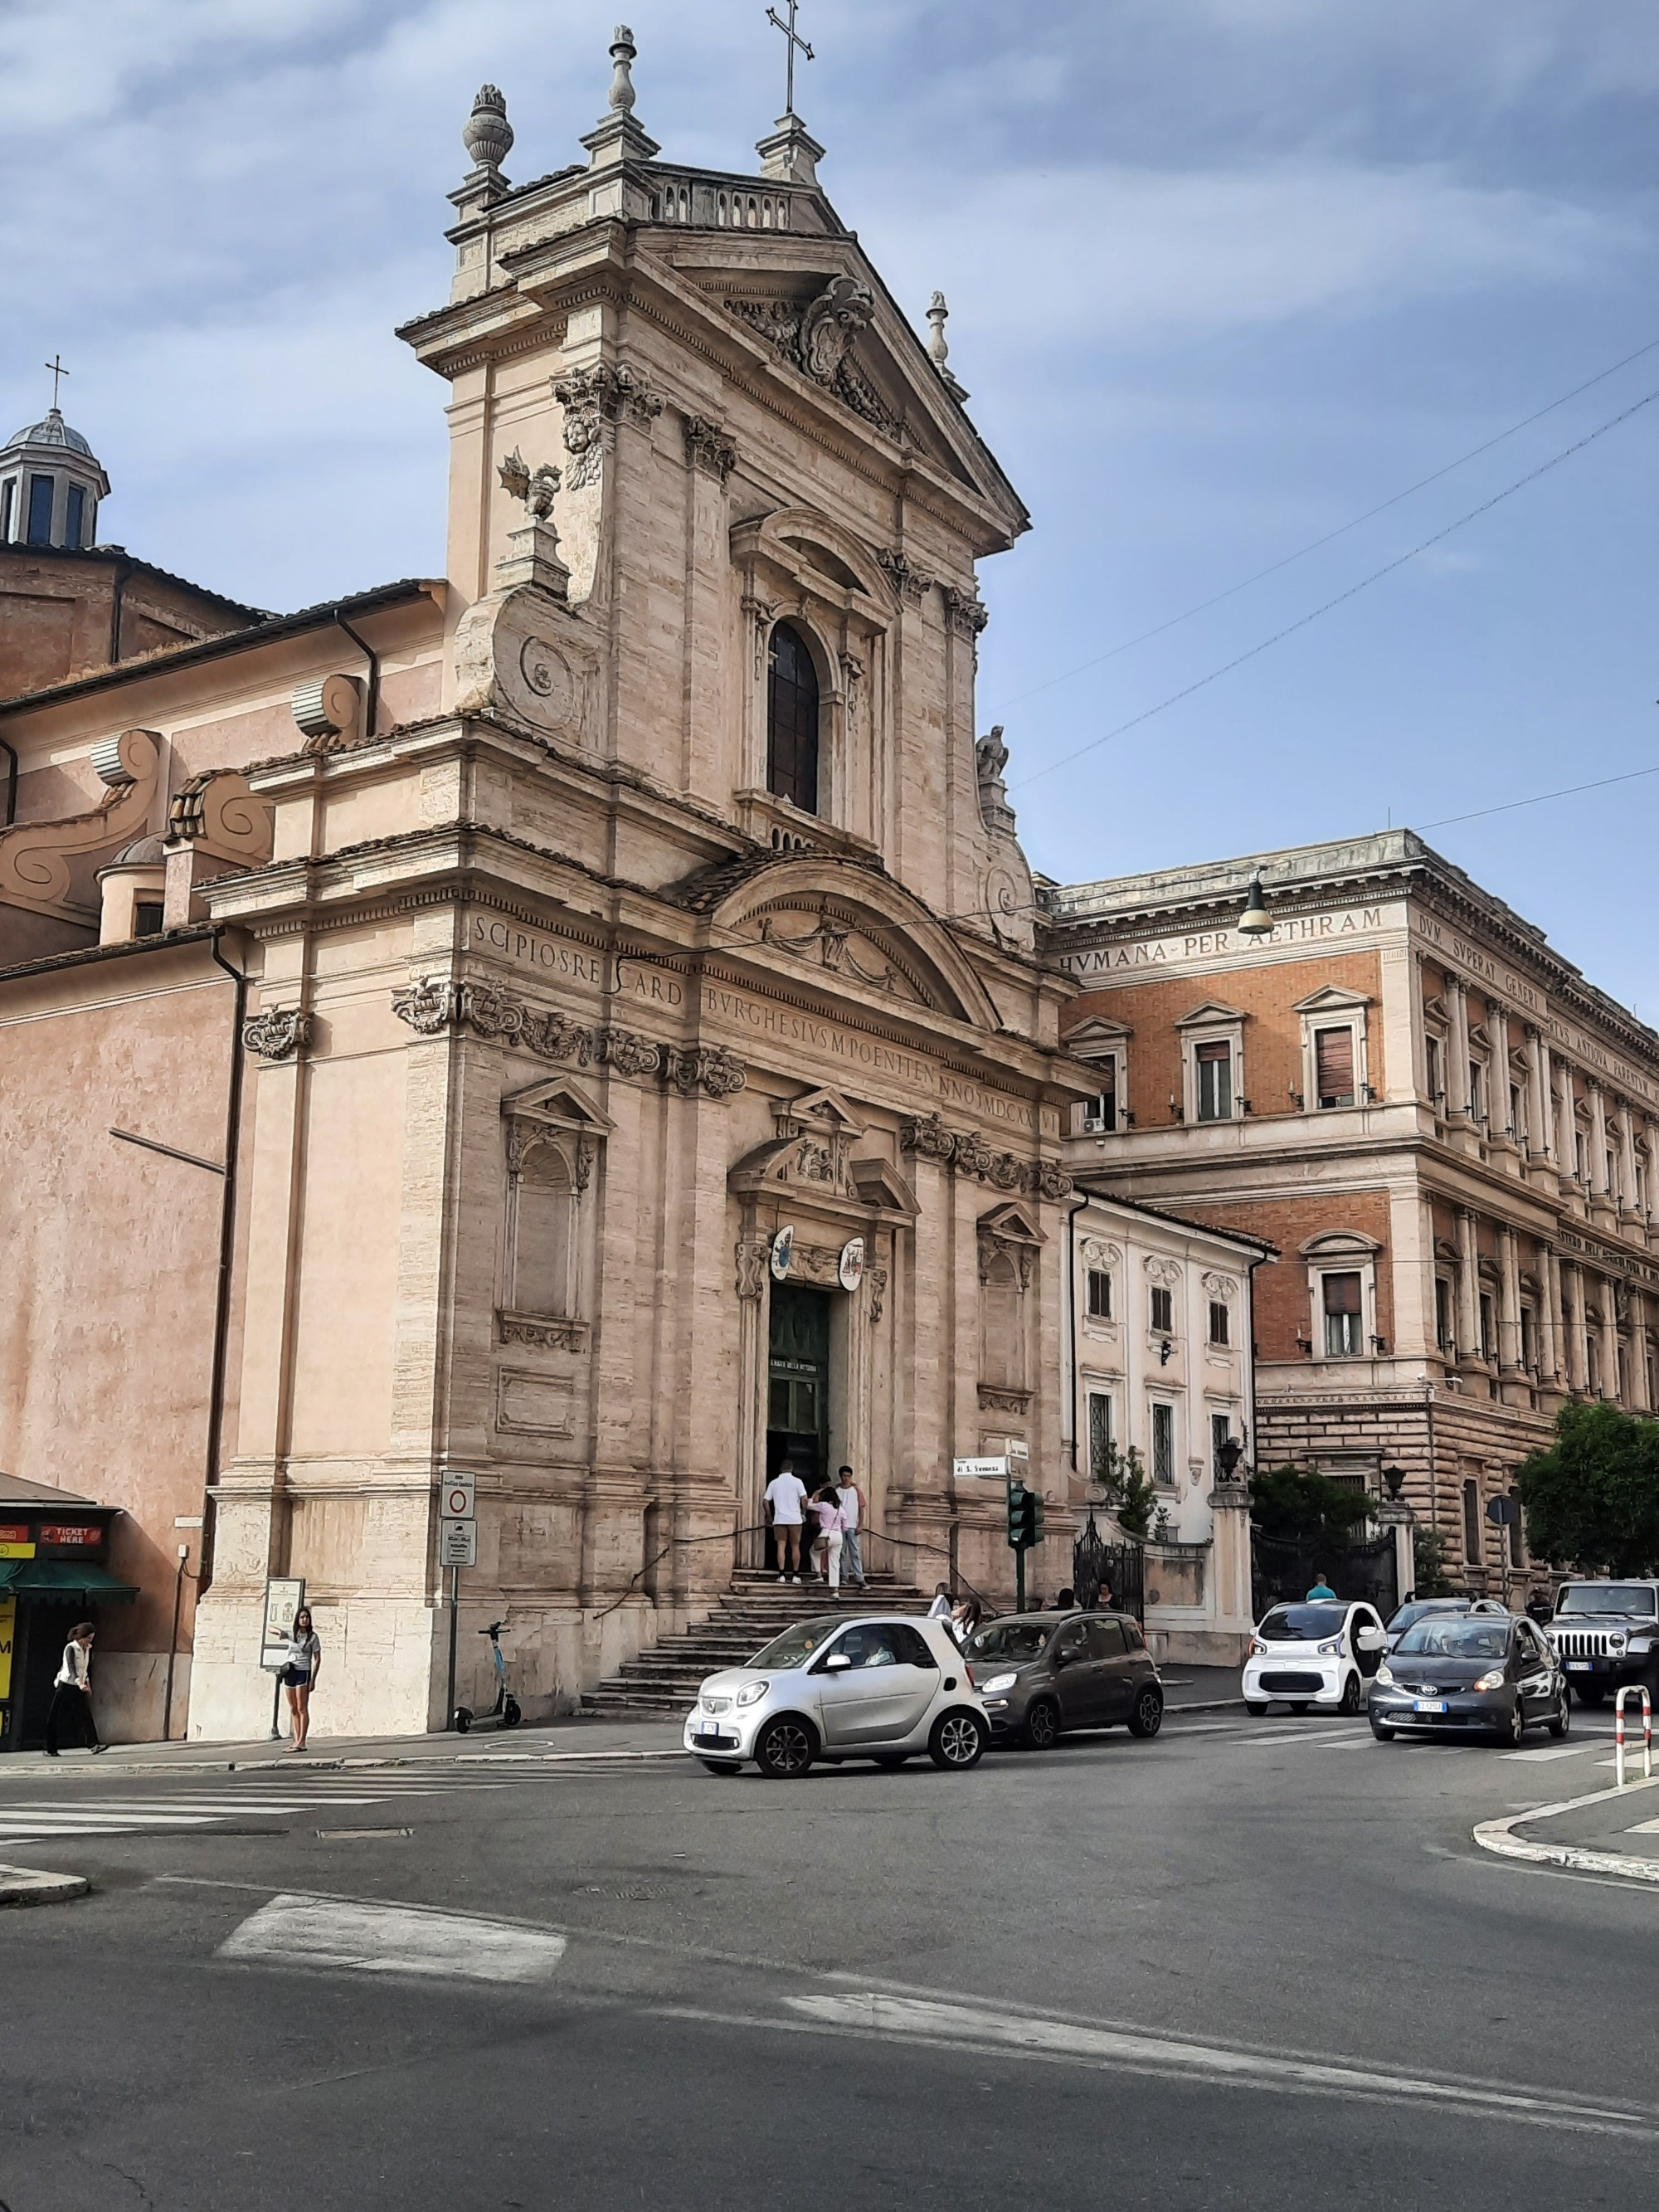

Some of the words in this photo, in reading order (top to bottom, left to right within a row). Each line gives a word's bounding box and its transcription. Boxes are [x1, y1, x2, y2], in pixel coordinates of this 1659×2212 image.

[1185, 933, 1229, 957] PER
[1453, 937, 1496, 982] SVPERAT
[1505, 974, 1539, 1011] GENERI
[617, 964, 683, 1006] CARD
[707, 987, 828, 1049] BVRGHESIVS
[56, 1527, 89, 1536] TICKET
[60, 1536, 85, 1544] HERE
